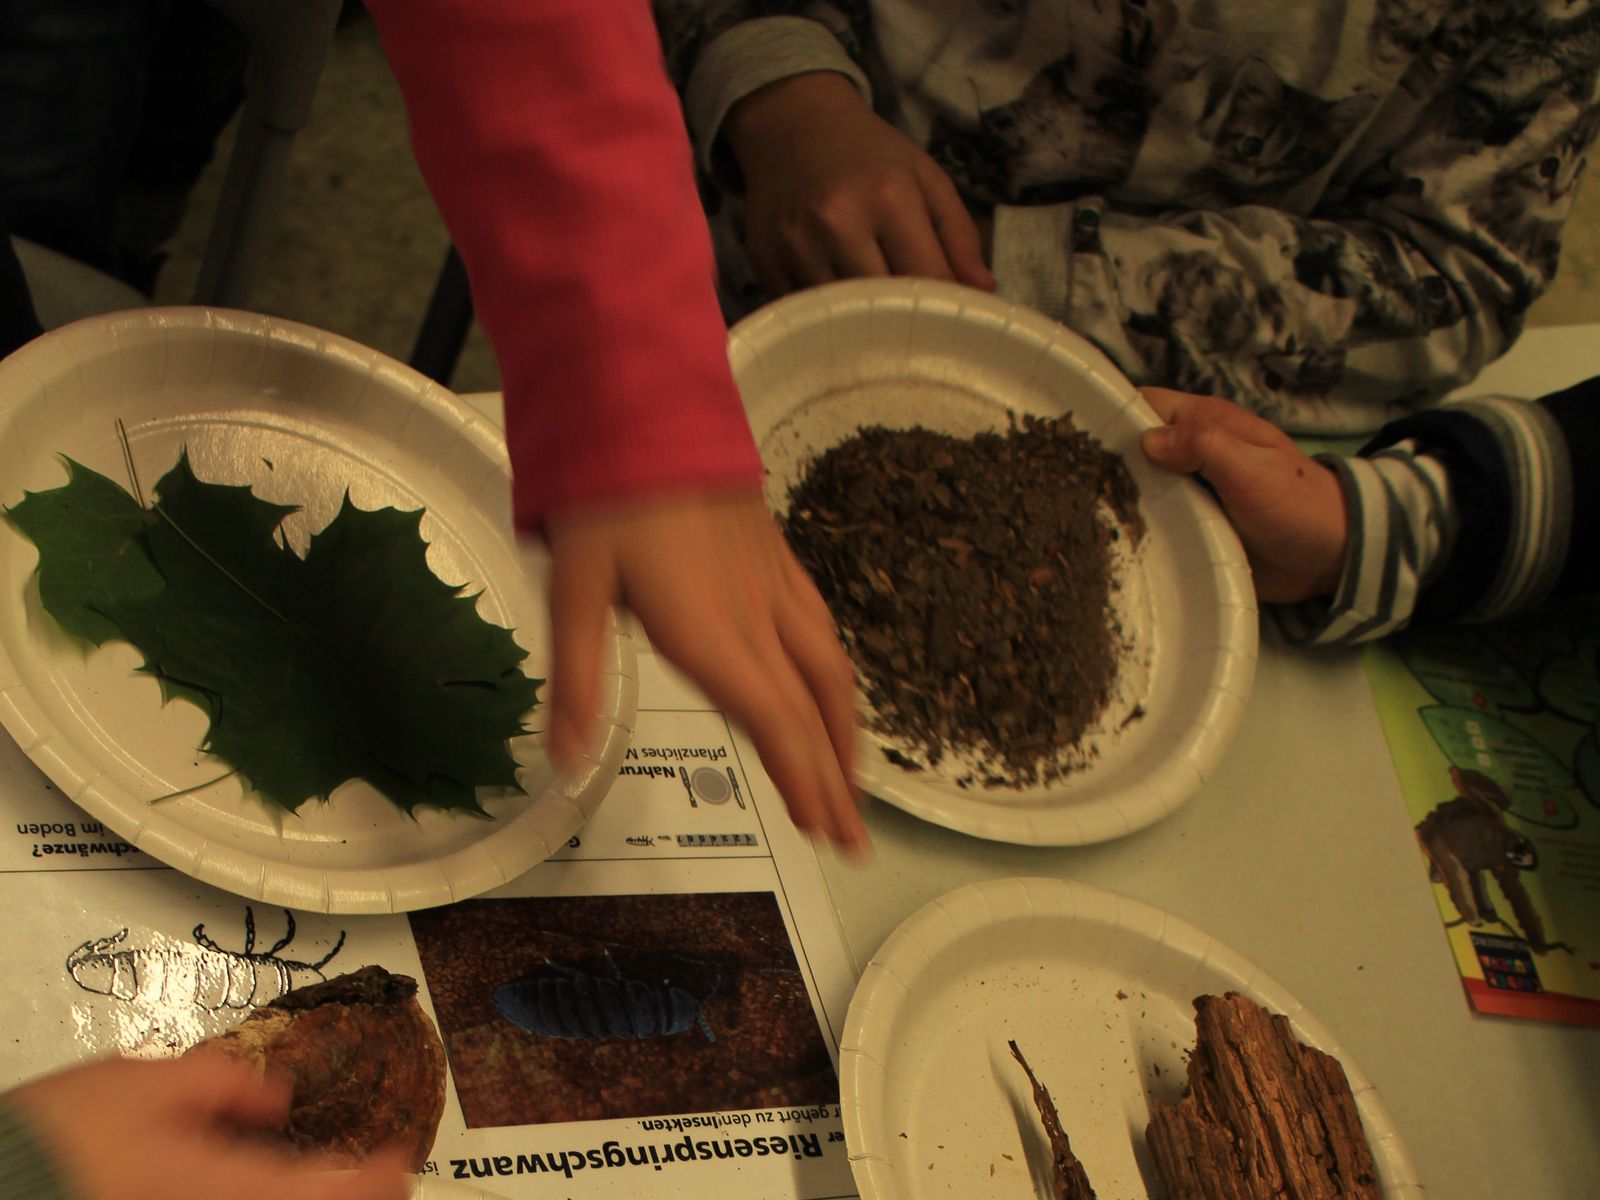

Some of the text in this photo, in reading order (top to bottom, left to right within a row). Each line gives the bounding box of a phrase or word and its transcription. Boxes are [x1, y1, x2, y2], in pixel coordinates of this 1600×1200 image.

[642, 746, 727, 761] pflanzliches
[17, 822, 104, 838] im Boden
[721, 1114, 751, 1127] den
[756, 1112, 774, 1122] zu
[780, 1104, 829, 1123] gehört
[637, 1117, 719, 1132] Insekten.
[450, 1133, 823, 1179] Riesenspringschwanz
